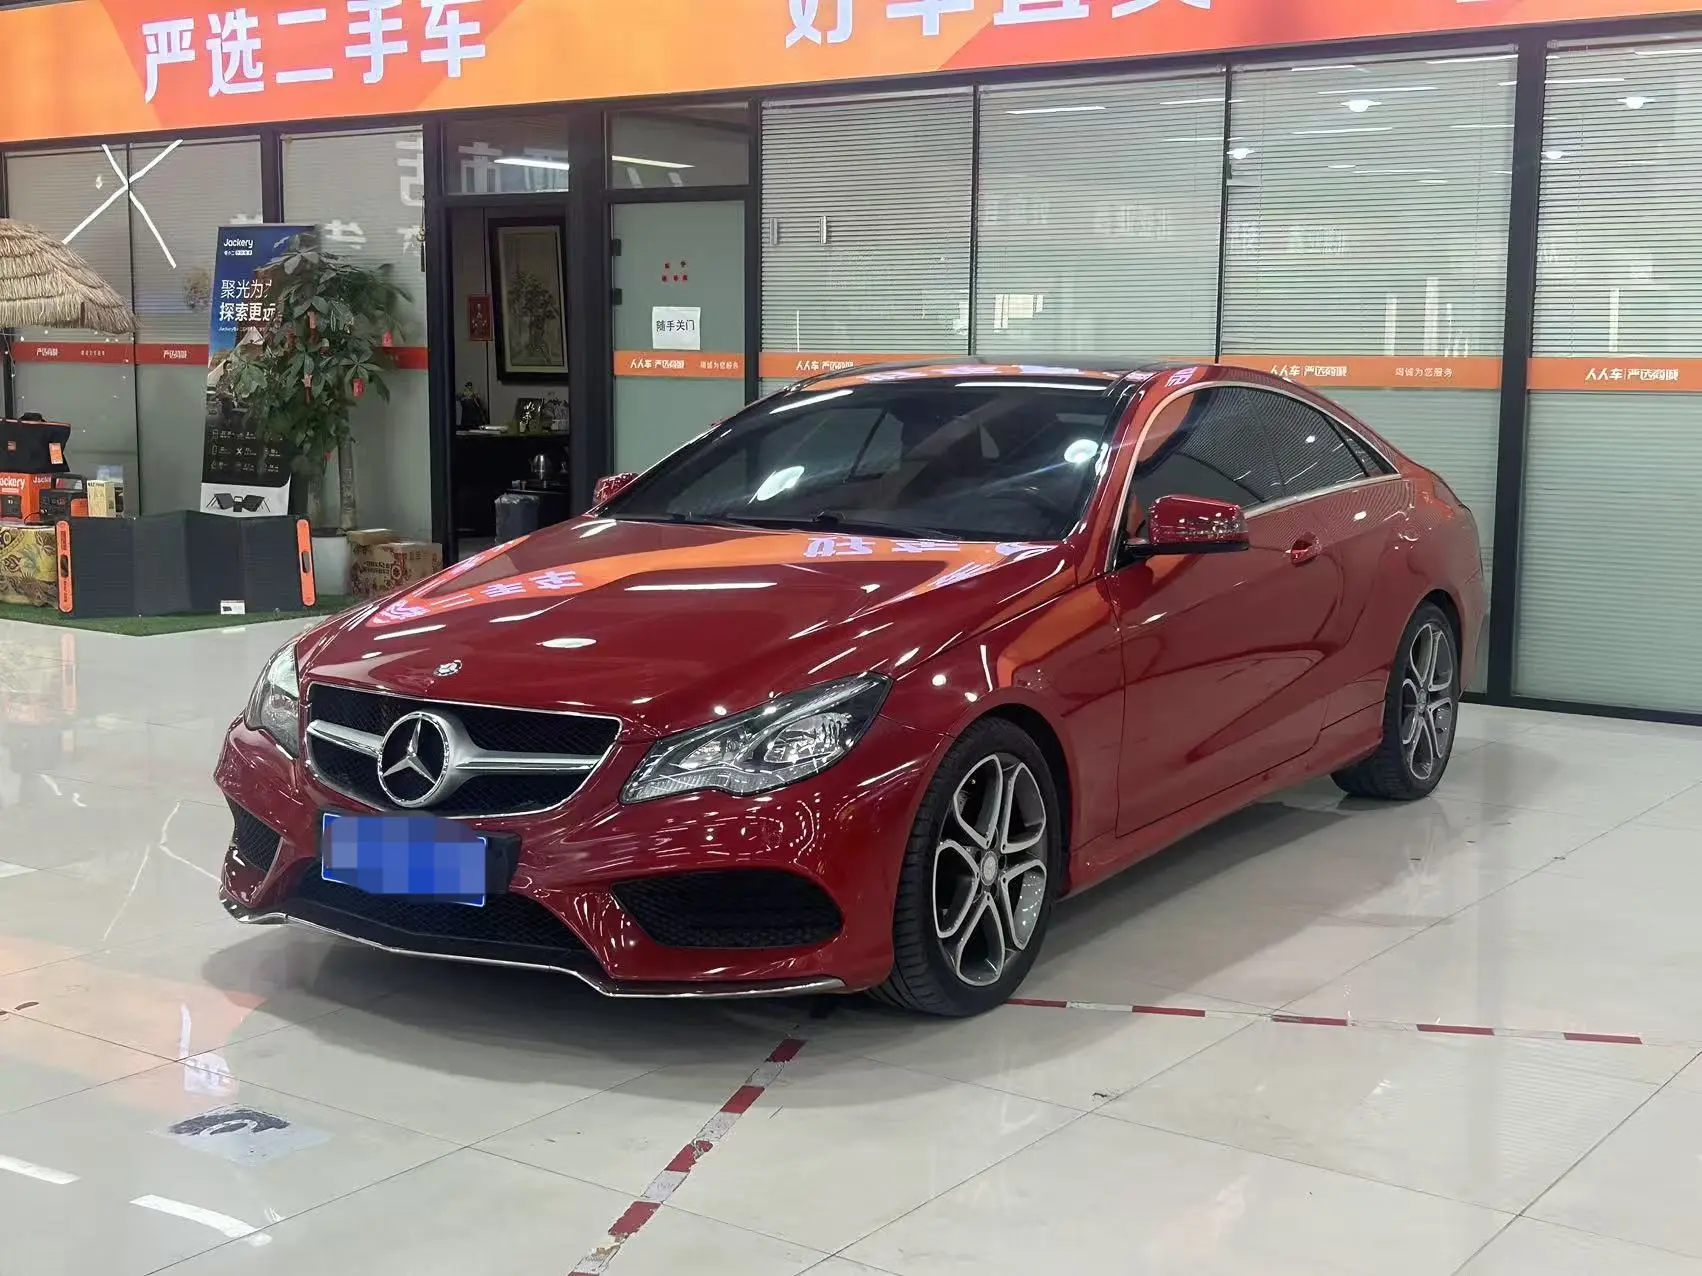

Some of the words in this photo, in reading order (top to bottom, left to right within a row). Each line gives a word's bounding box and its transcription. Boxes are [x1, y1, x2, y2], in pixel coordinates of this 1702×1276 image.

[143, 0, 486, 104] 严选二手车
[223, 238, 254, 249] Jackery
[656, 319, 695, 332] 随手关门
[1585, 367, 1623, 381] 人人车
